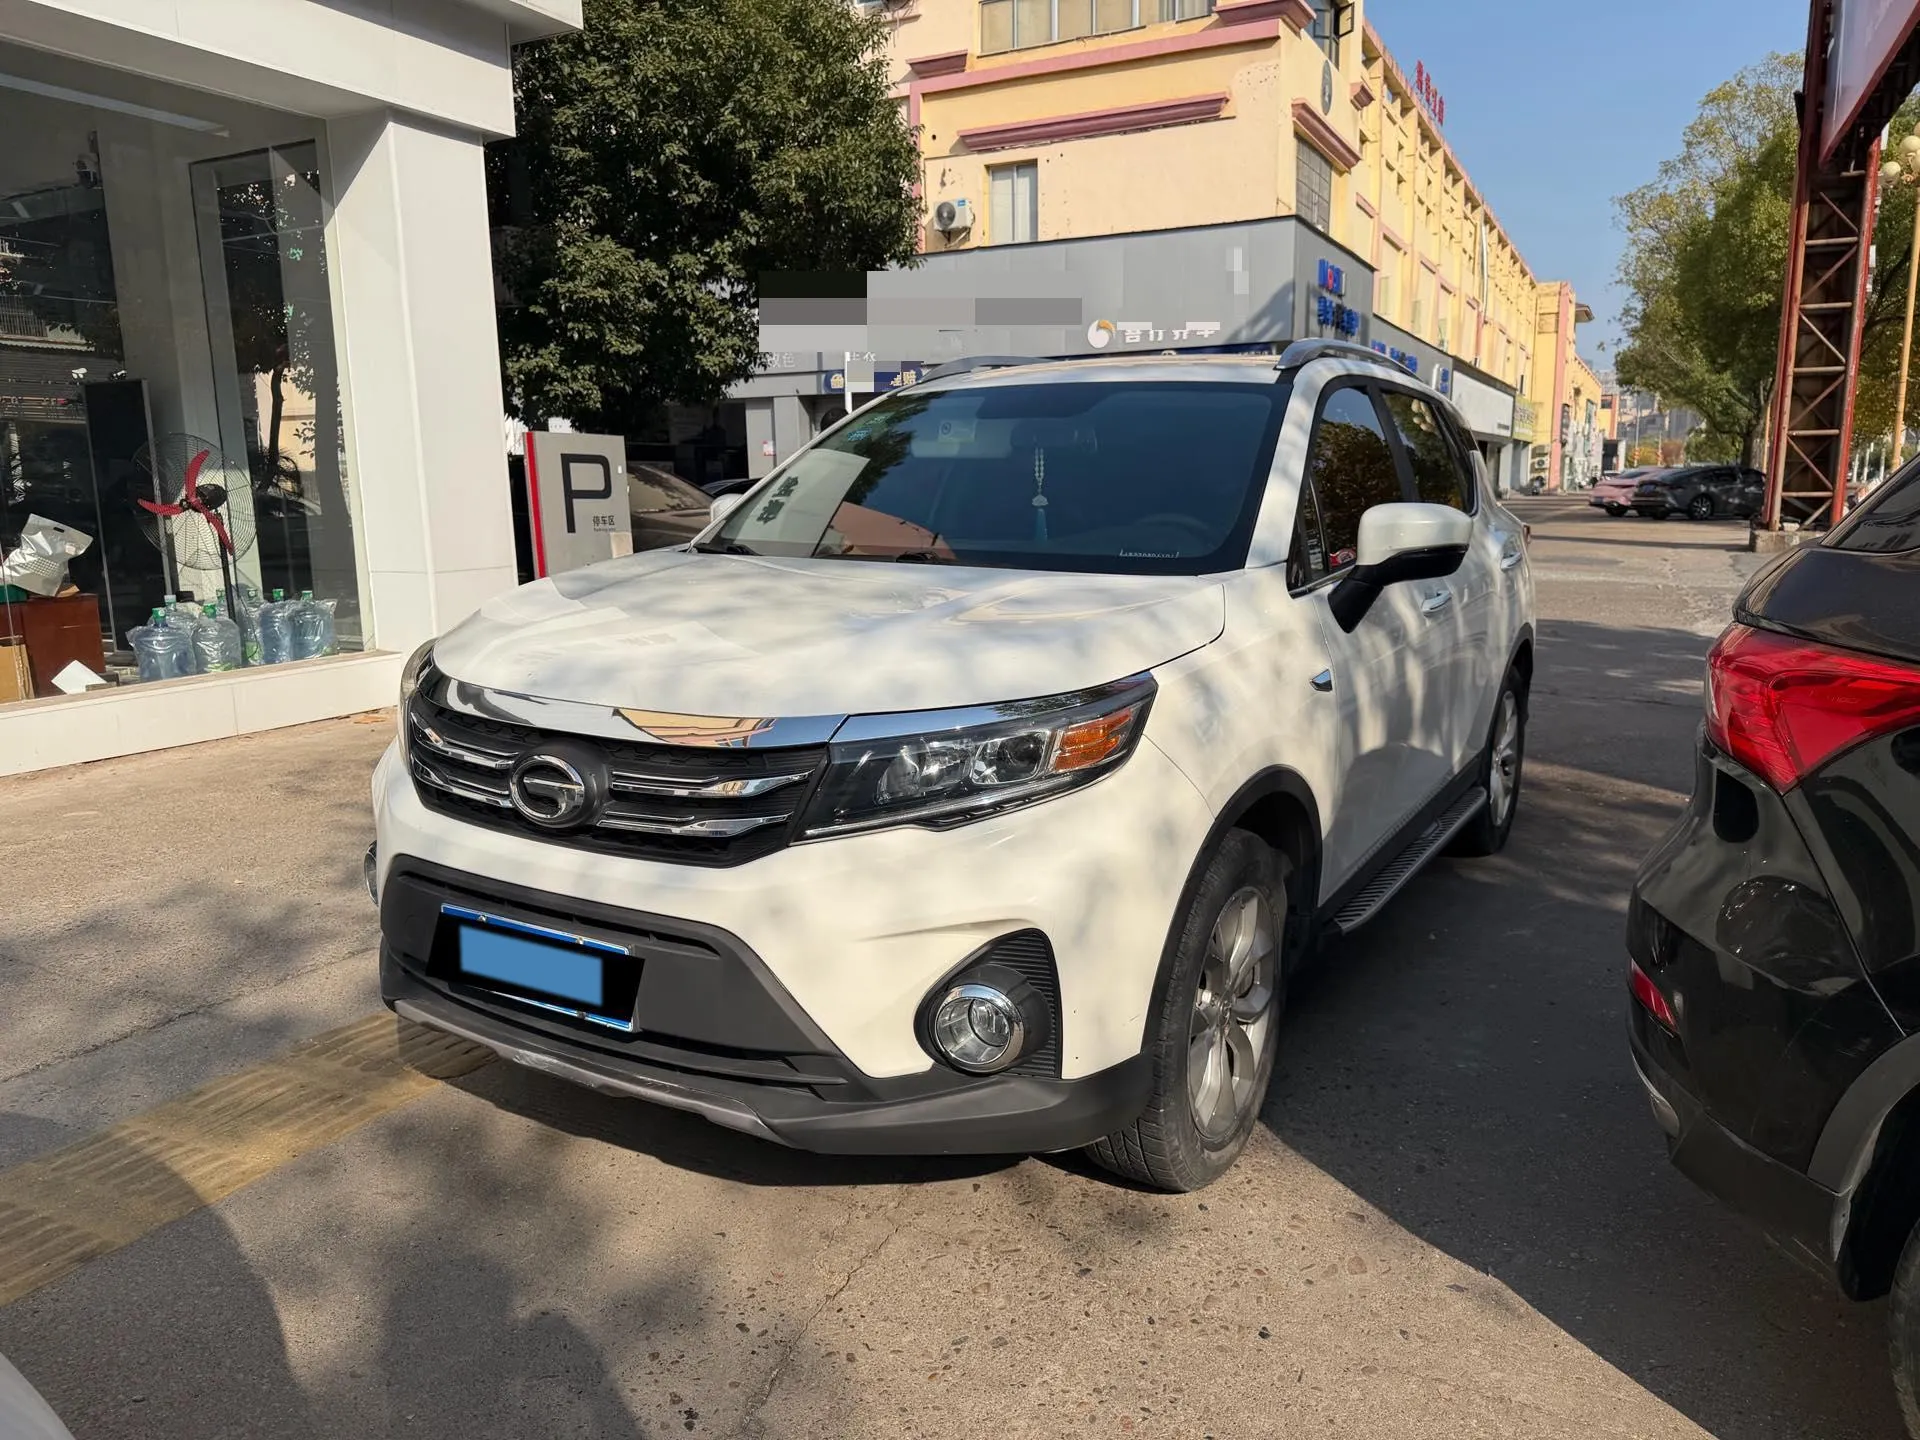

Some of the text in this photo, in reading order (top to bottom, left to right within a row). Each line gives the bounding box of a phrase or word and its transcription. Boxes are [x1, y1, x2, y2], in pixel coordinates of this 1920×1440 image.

[560, 453, 612, 533] P
[592, 515, 615, 527] 停车区
